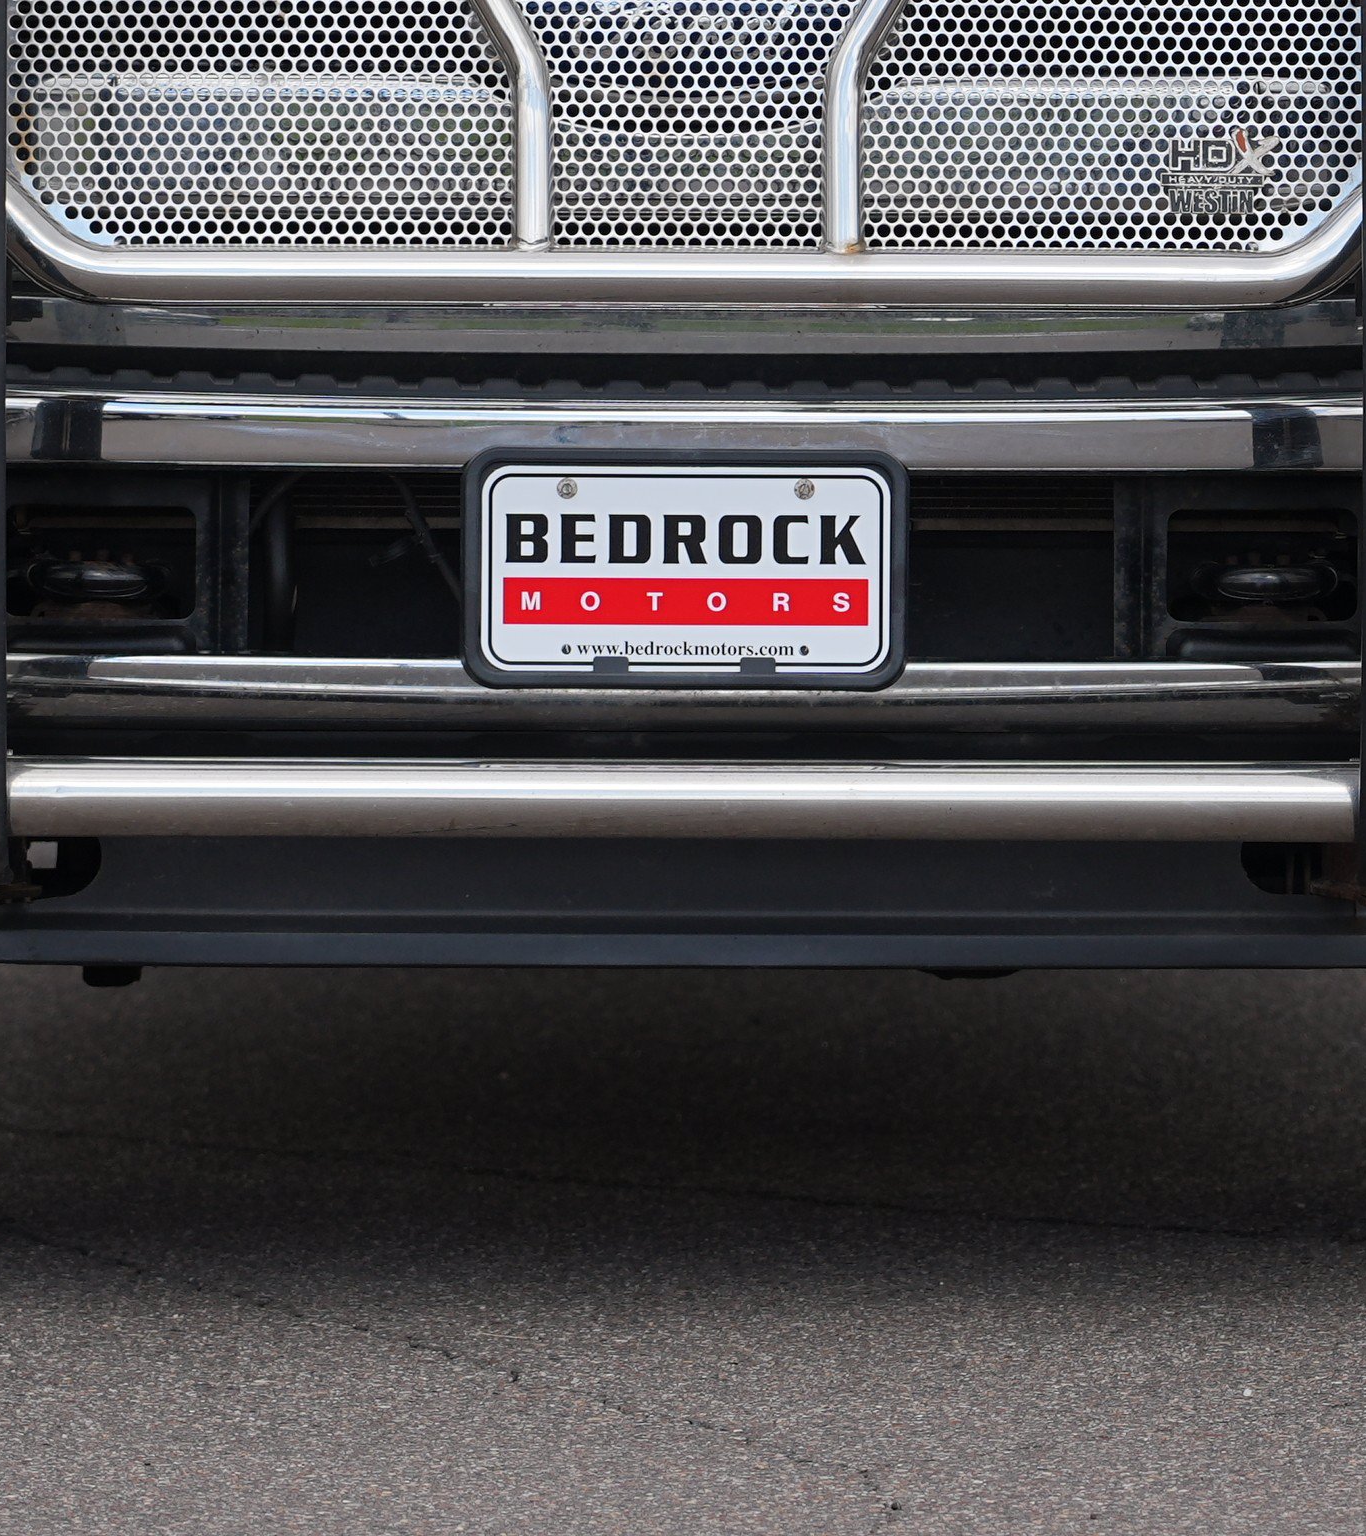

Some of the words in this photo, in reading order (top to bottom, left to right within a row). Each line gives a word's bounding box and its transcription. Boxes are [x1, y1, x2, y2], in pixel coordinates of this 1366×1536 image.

[505, 513, 867, 564] BEDROCK
[520, 590, 851, 613] MOTORS
[577, 641, 795, 656] www.bedrockmotors.com
